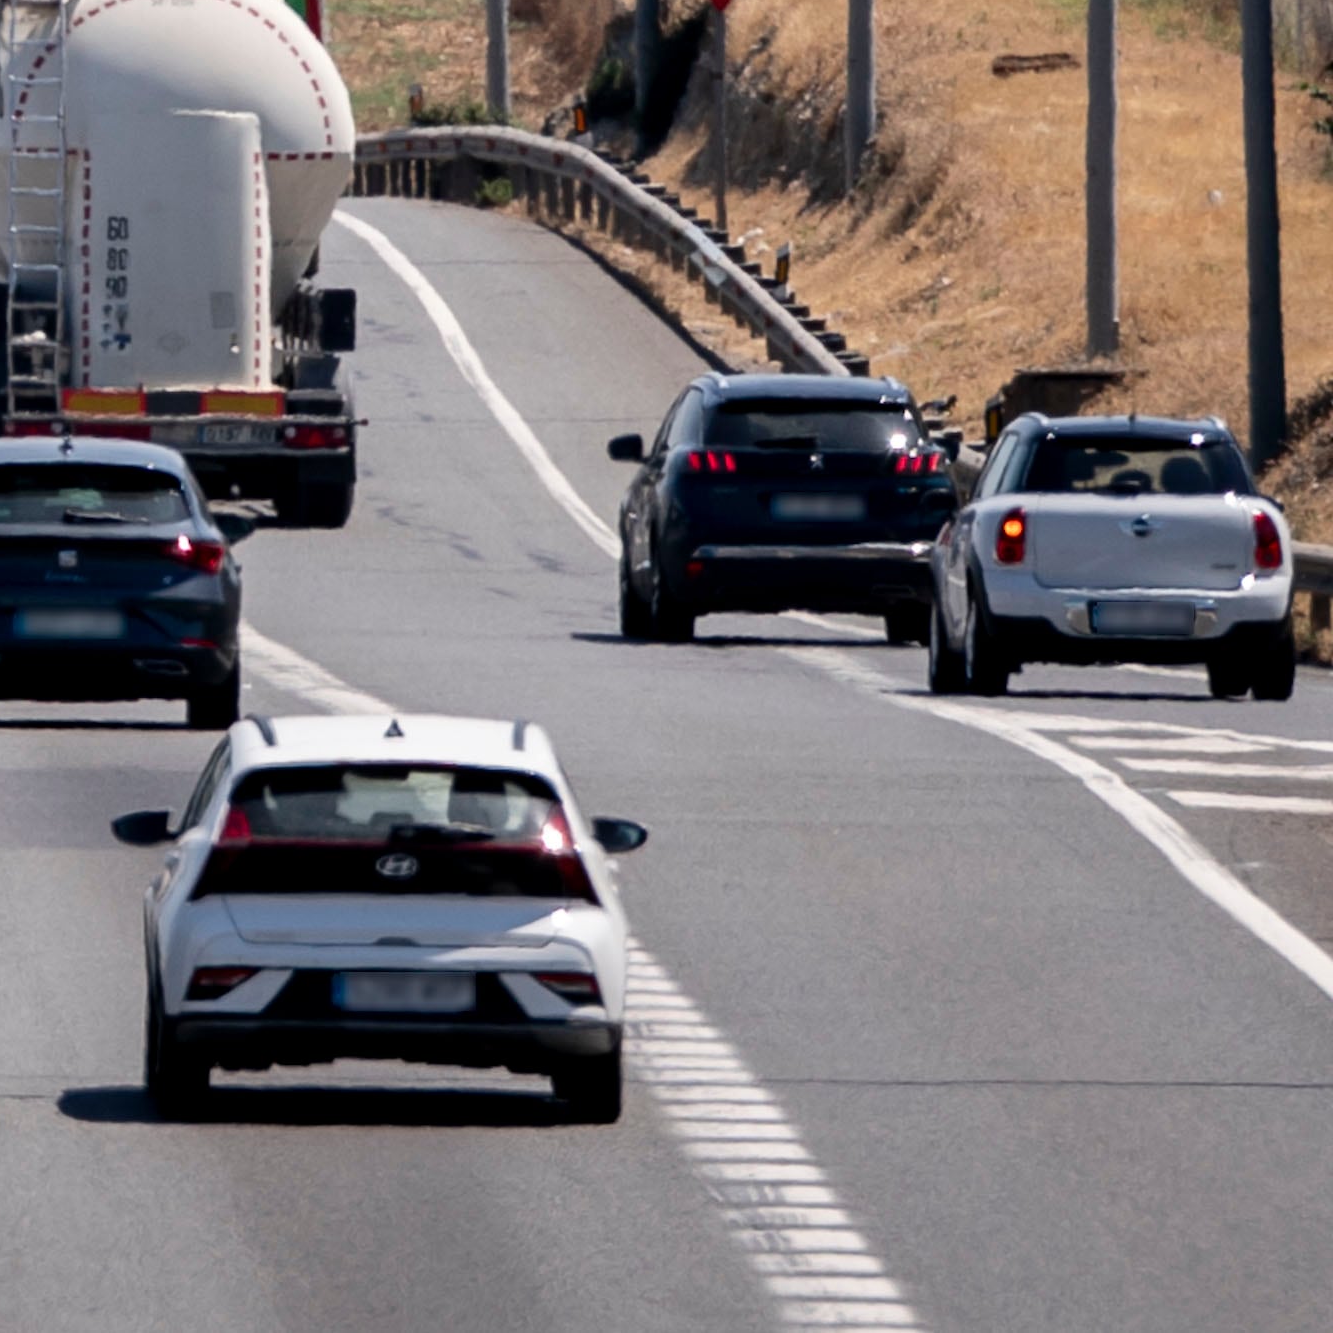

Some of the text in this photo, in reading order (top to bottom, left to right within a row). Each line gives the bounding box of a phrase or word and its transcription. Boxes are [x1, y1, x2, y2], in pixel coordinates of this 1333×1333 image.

[107, 216, 129, 240] 60
[106, 248, 129, 271] 80
[105, 275, 127, 299] 90
